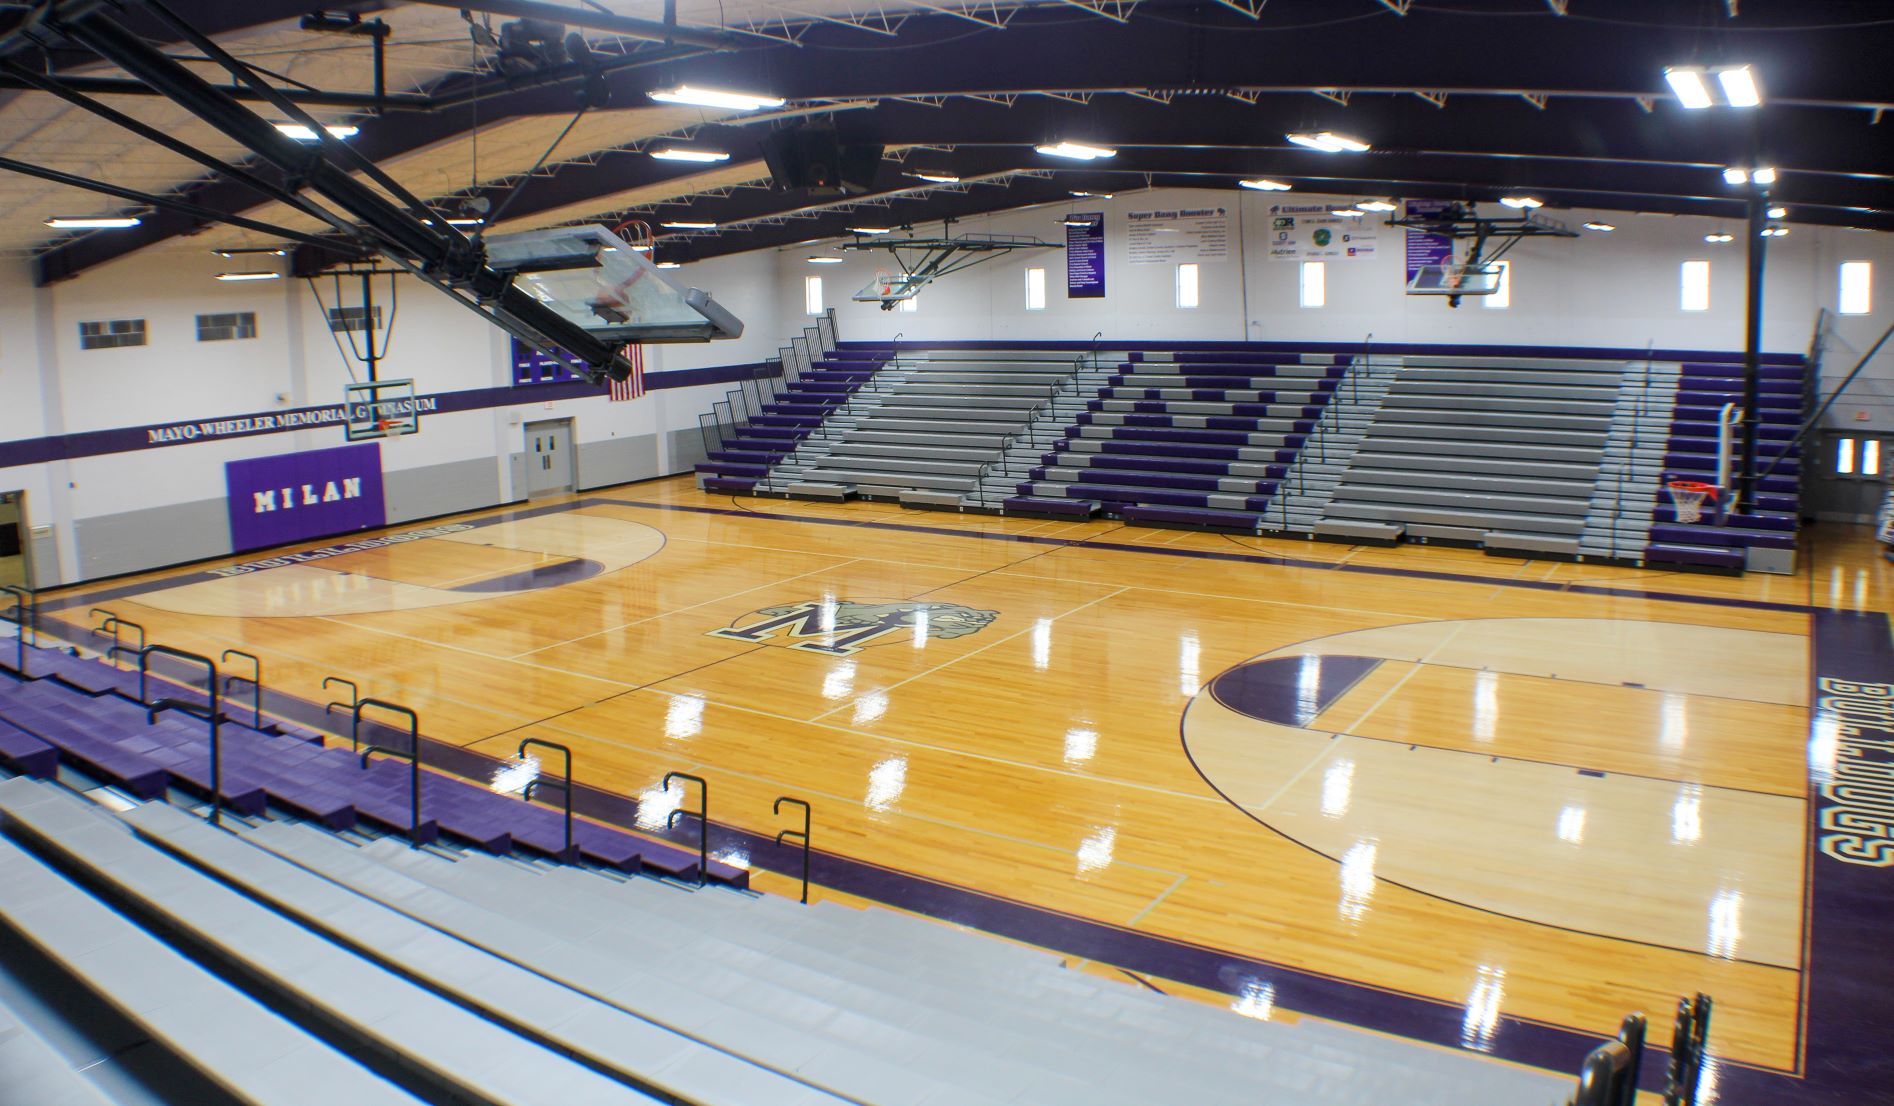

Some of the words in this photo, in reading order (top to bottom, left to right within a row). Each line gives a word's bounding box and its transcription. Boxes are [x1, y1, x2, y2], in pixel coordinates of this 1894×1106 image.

[1128, 211, 1152, 221] Super
[149, 417, 275, 443] MAYO-WHEELER
[254, 478, 362, 513] MILAN
